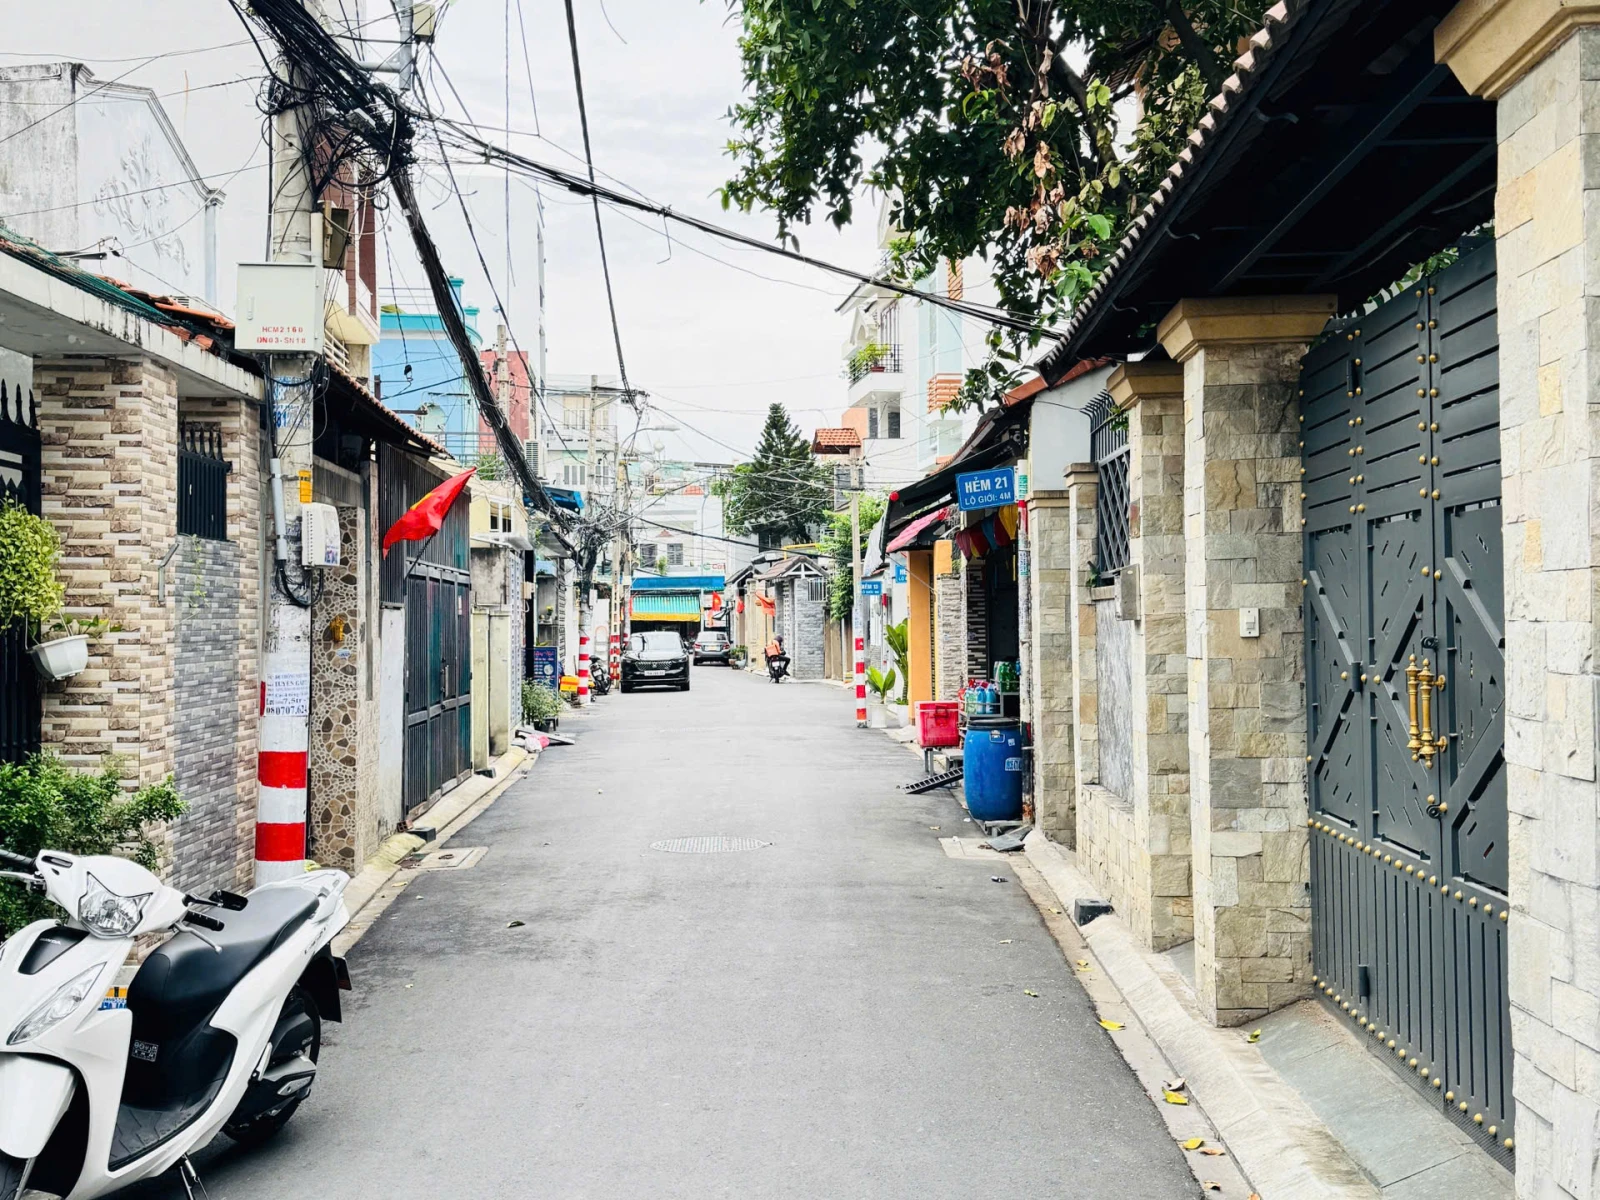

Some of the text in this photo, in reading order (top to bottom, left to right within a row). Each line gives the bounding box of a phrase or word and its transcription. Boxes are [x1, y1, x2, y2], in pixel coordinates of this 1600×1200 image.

[964, 476, 991, 493] HẺM
[994, 476, 1008, 490] 21
[964, 491, 1012, 506] LỘ GIỚI: 4M
